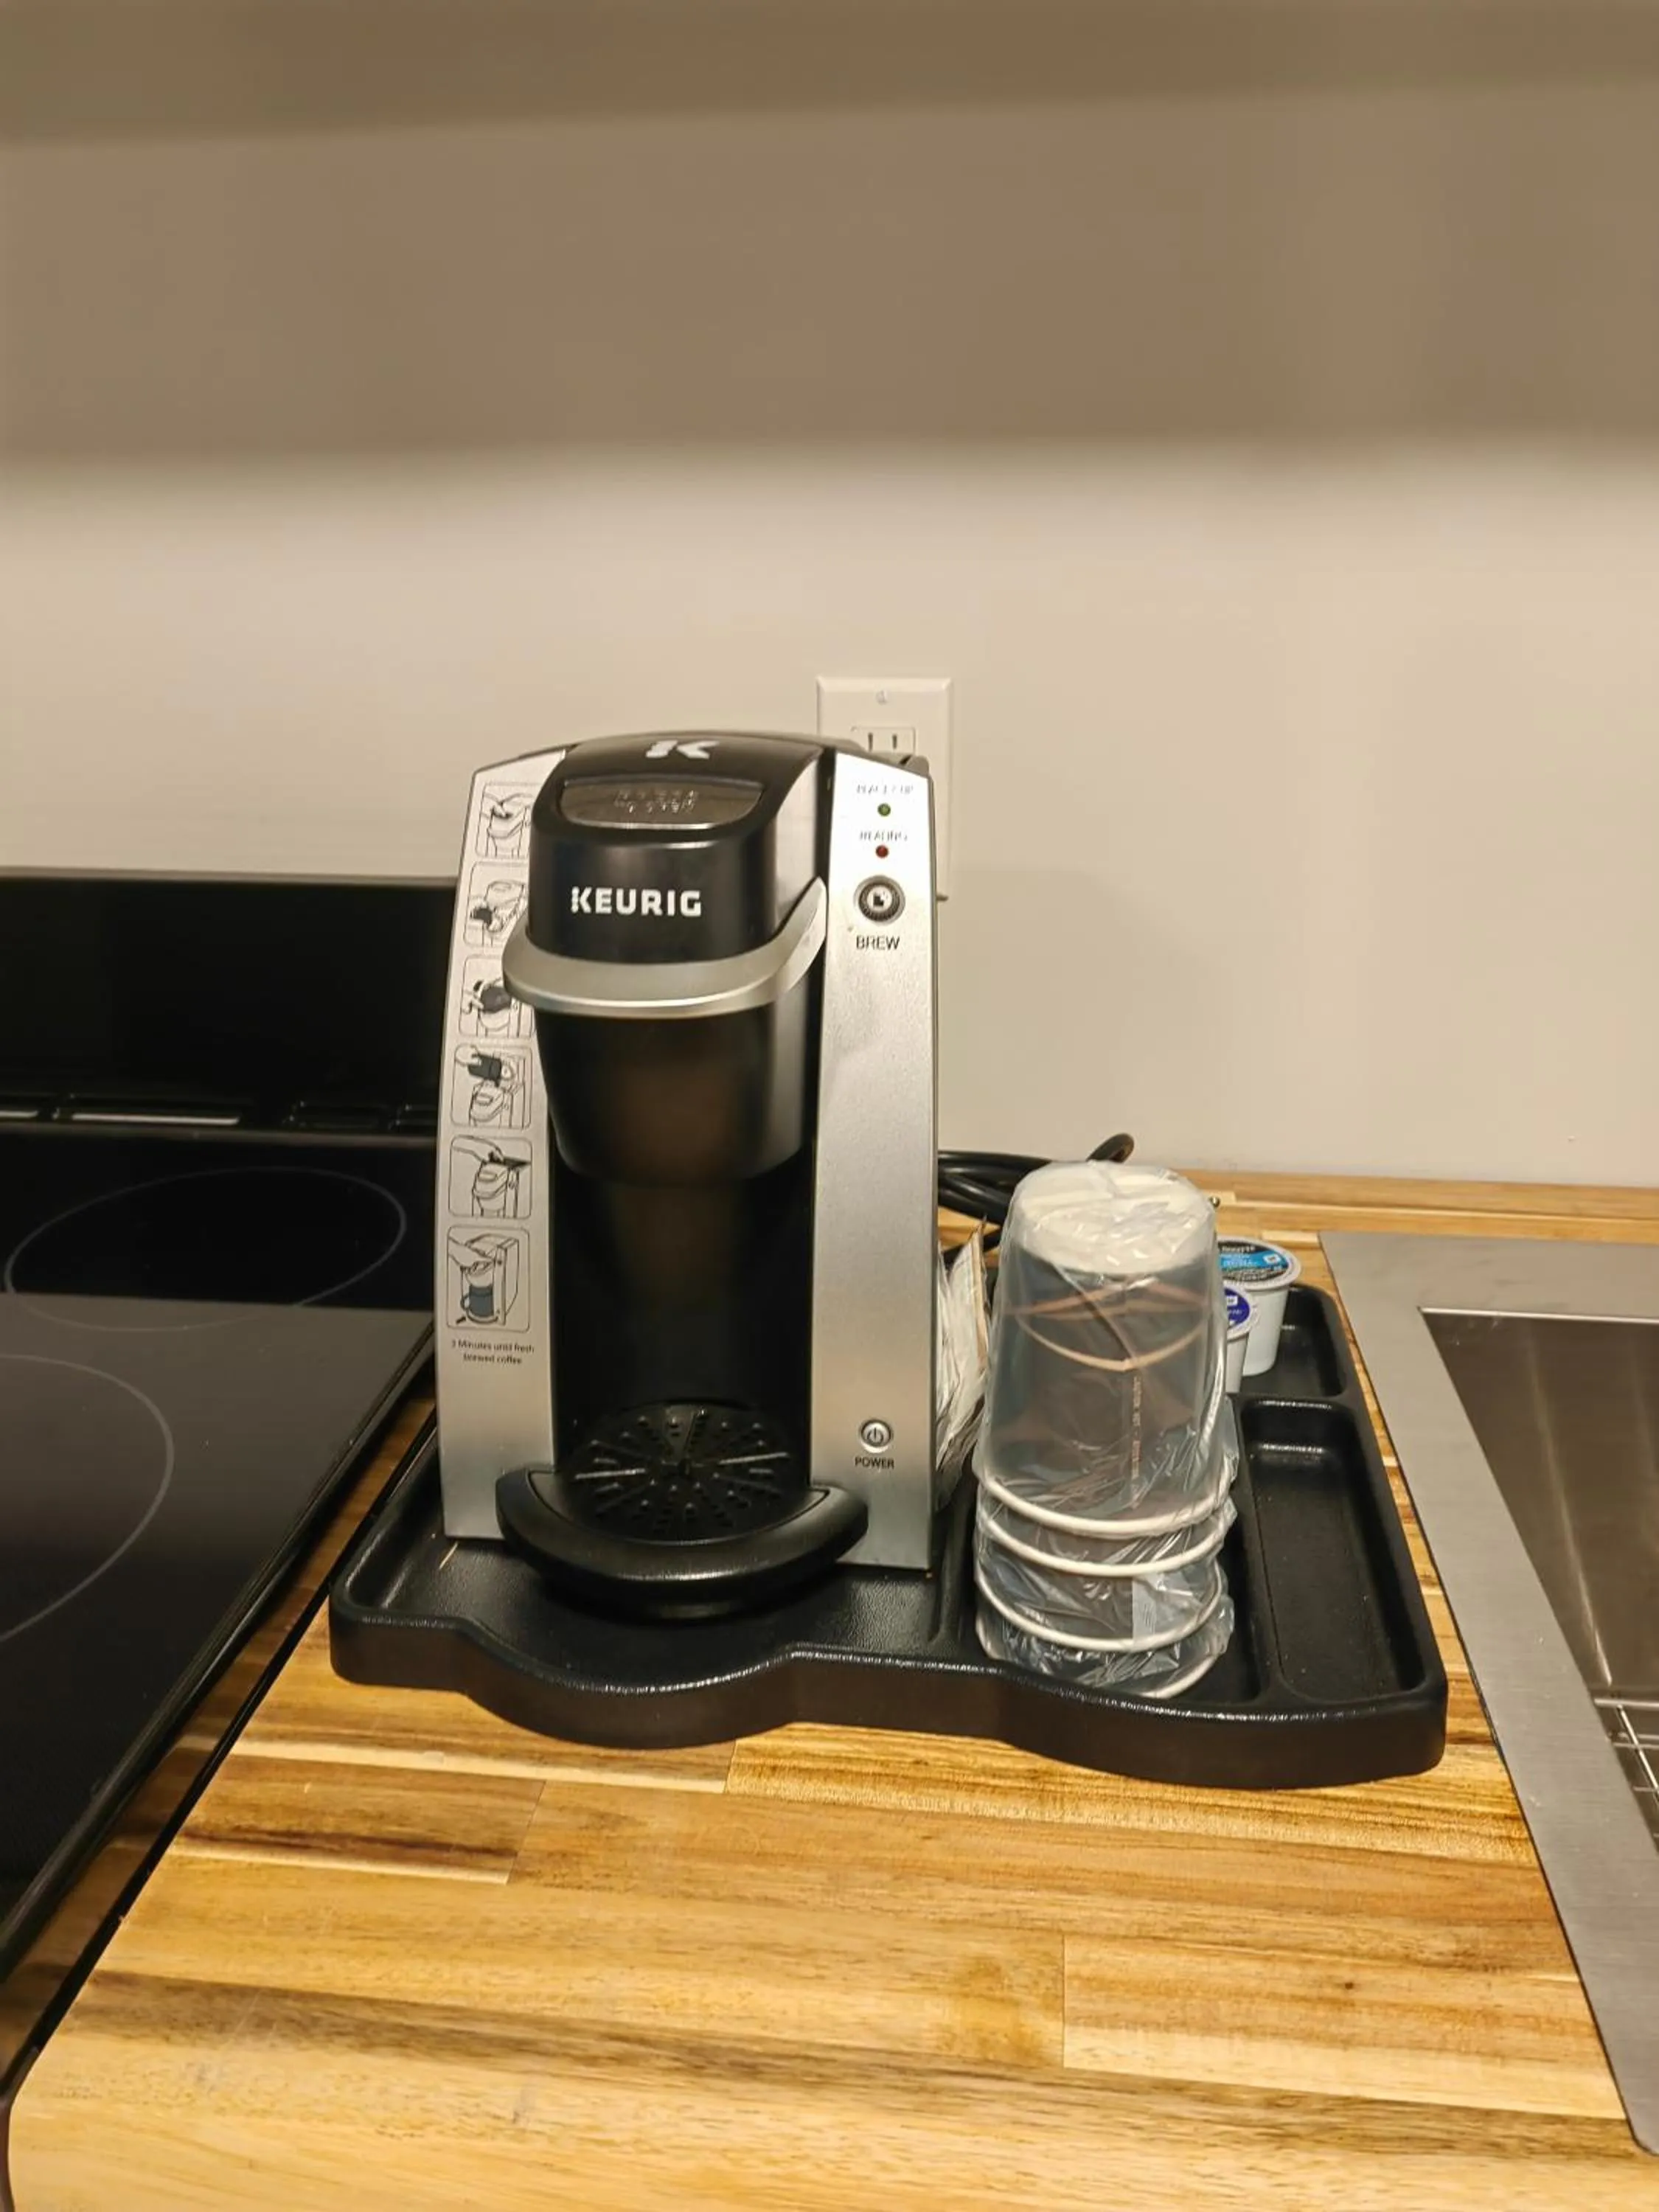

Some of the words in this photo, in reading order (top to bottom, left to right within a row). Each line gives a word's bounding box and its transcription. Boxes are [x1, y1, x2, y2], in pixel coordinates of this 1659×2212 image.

[571, 886, 701, 917] KEURIG
[856, 935, 900, 950] BREW
[855, 1456, 894, 1470] POWER
